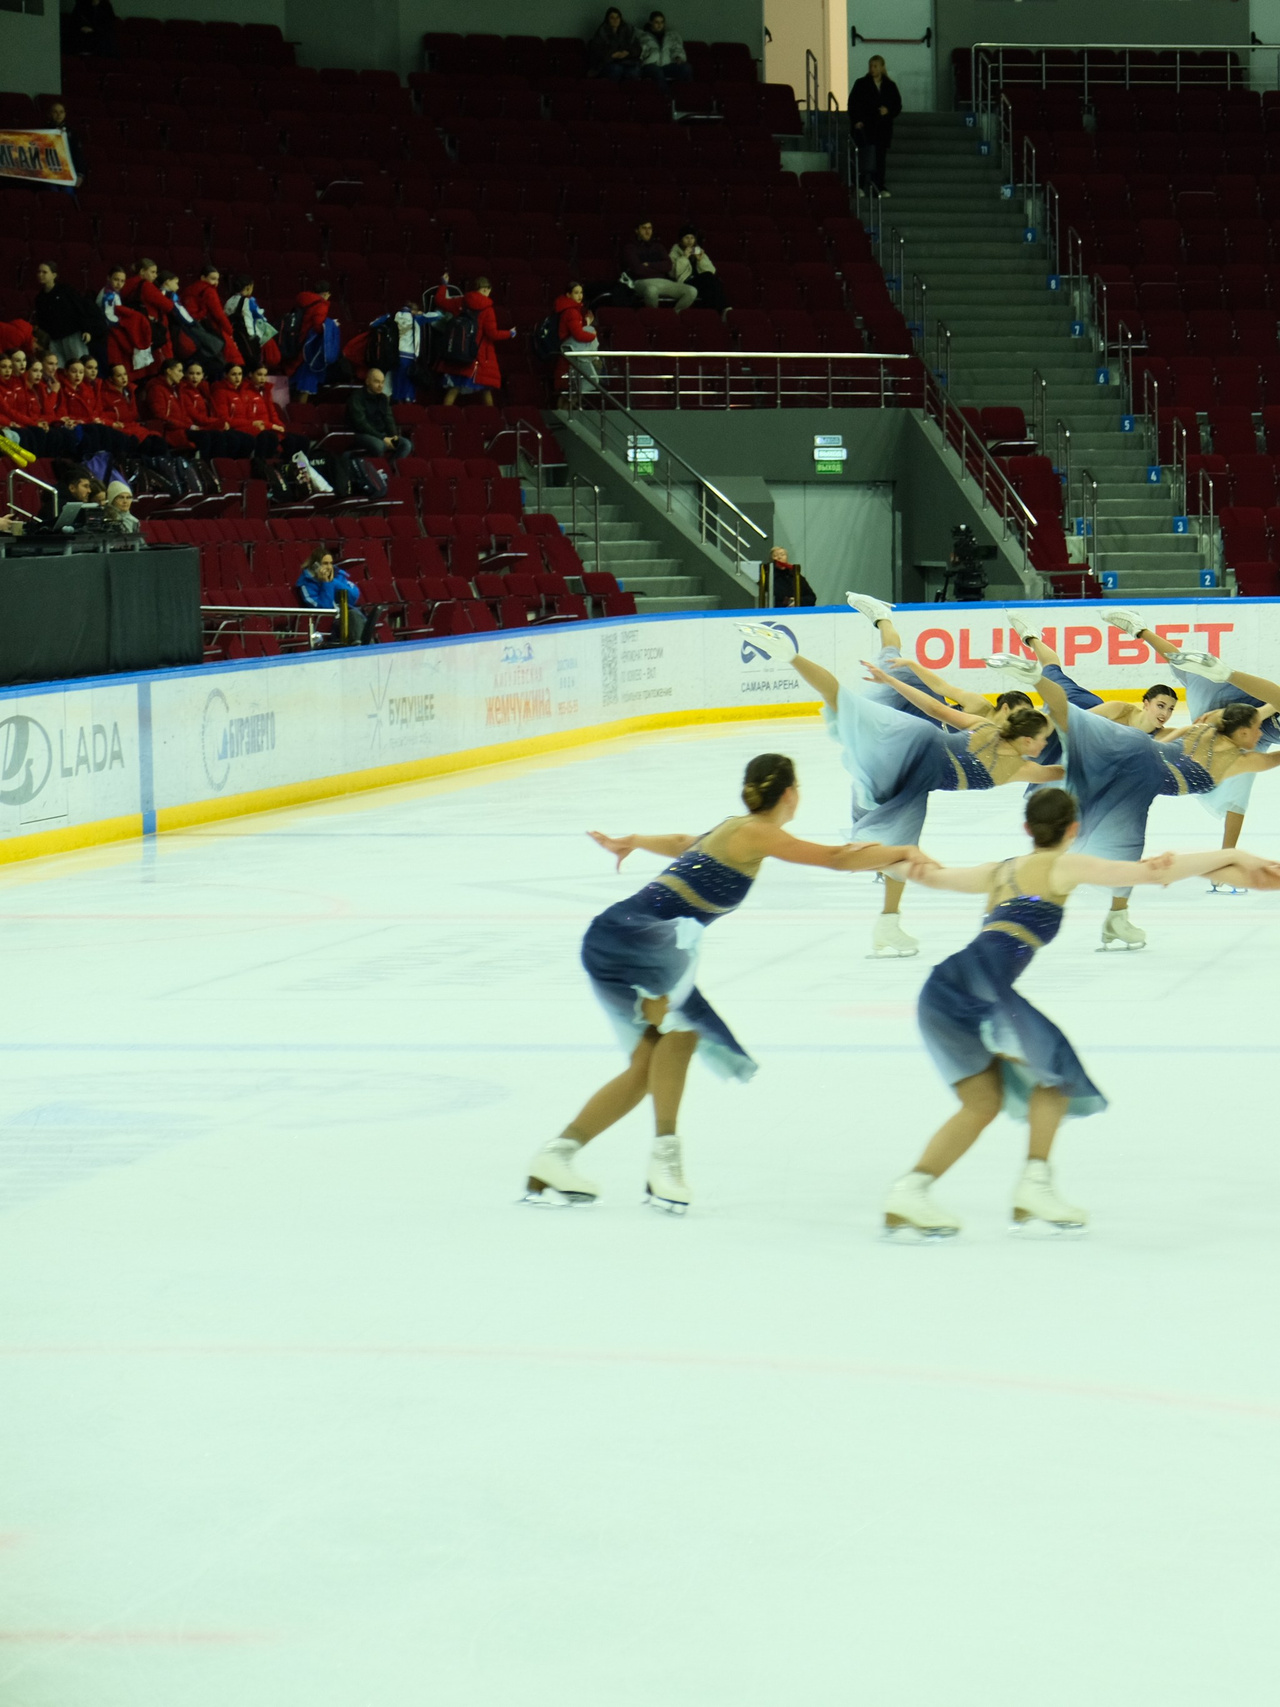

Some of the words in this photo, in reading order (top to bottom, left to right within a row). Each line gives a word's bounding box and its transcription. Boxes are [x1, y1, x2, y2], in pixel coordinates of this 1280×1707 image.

[965, 117, 974, 127] 12
[980, 145, 988, 154] 11
[1026, 232, 1032, 242] 9
[1050, 279, 1056, 289] 8
[1074, 325, 1080, 334] 7
[1099, 373, 1105, 384] 6
[1124, 420, 1130, 430] 5
[1150, 471, 1157, 481] 4
[1177, 521, 1183, 532] 3
[1107, 577, 1113, 588] 2
[1204, 575, 1211, 585] 2
[915, 623, 1235, 669] OLIMPBET
[741, 680, 771, 693] САМАРА
[772, 679, 800, 691] АРЕНА
[388, 694, 435, 729] БУДУЩЕЕ
[59, 721, 125, 778] LADA
